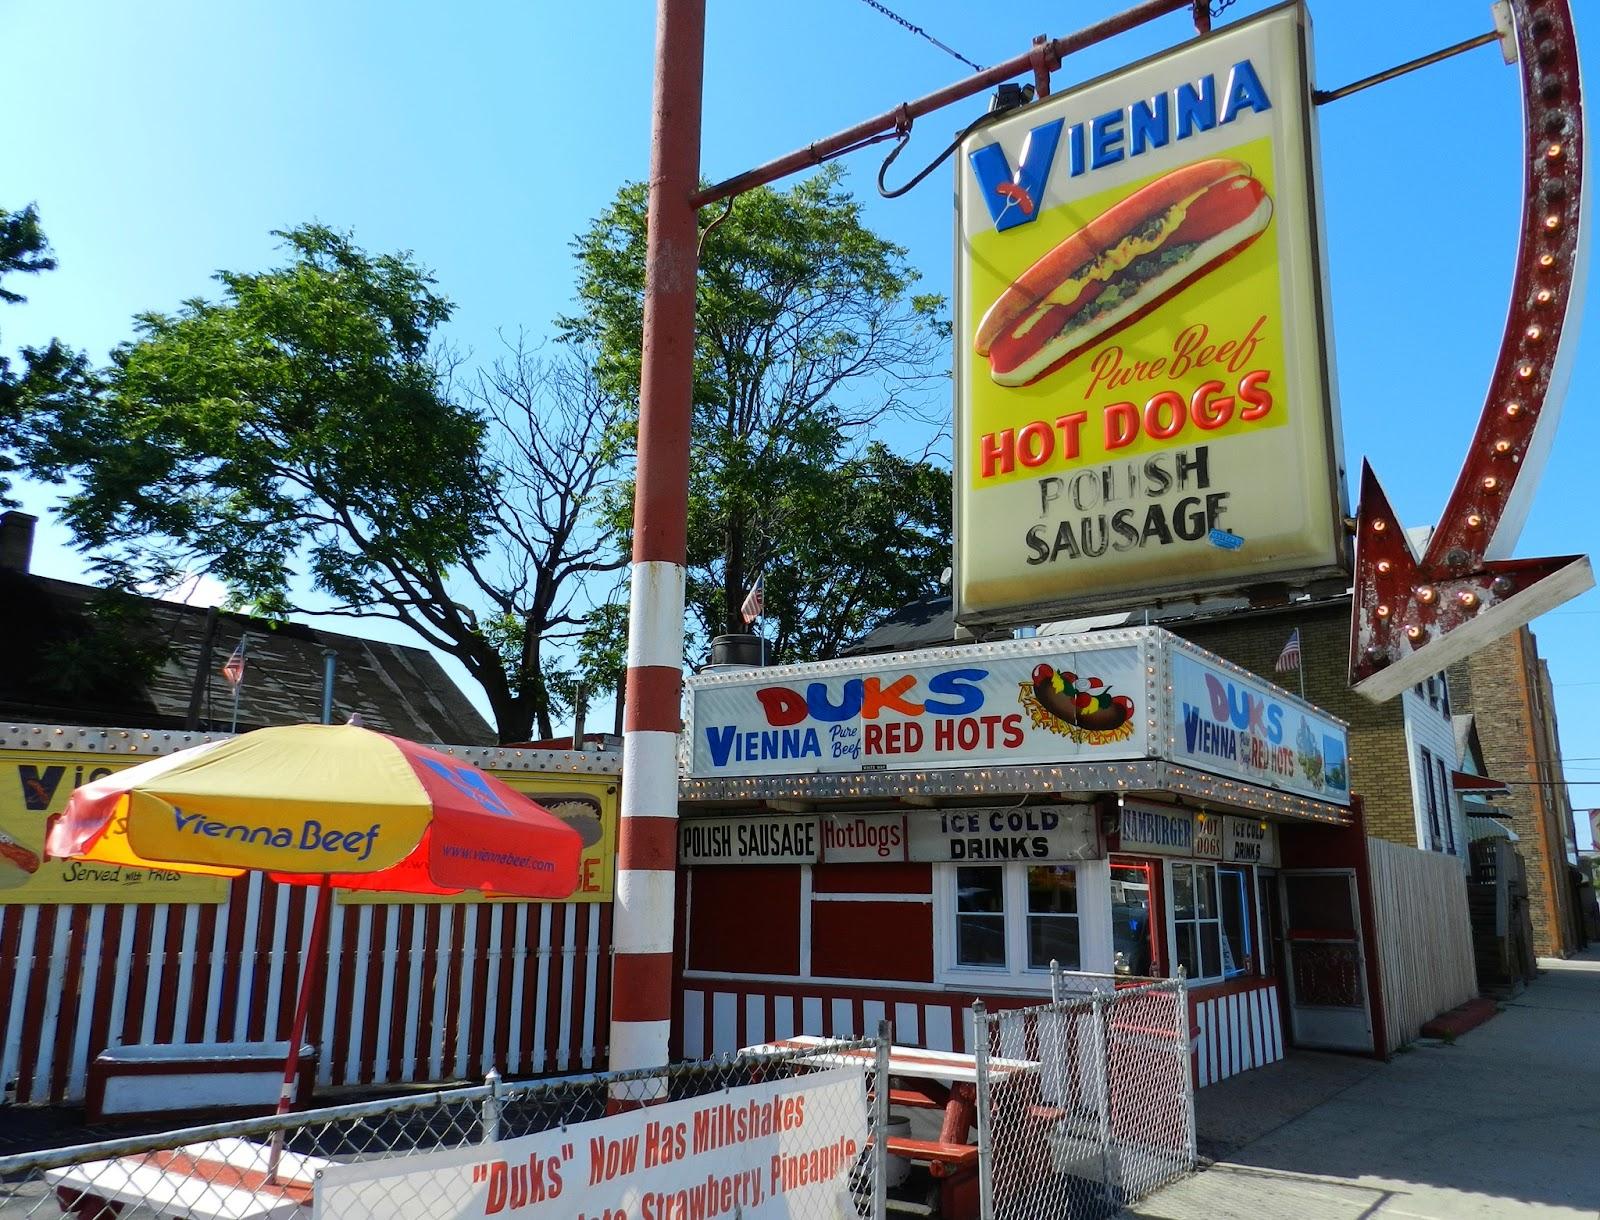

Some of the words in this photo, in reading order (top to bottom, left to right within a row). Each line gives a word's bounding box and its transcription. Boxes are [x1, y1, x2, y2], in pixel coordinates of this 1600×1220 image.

[968, 59, 1272, 232] VIENNA
[1084, 346, 1167, 399] Pure
[1168, 315, 1267, 379] Beef
[981, 411, 1088, 478] HOT
[1104, 370, 1273, 450] DOGS
[1038, 446, 1210, 519] POLISH
[1025, 491, 1232, 565] SAUSAGE
[756, 668, 989, 726] DUKS
[1204, 672, 1284, 745] DUKS
[706, 725, 821, 766] VIENNA
[829, 724, 858, 742] Pure
[831, 739, 861, 760] Beef
[864, 722, 923, 754] RED
[935, 714, 1025, 752] HOTS
[1183, 702, 1236, 761] VIENNA
[1251, 736, 1269, 770] RED
[1271, 745, 1295, 777] HOTS
[174, 806, 293, 848] Vienna
[298, 820, 381, 861] Beef
[683, 824, 731, 857] POLISH
[738, 822, 815, 856] SAUSAGE
[824, 819, 900, 857] HotDogs
[940, 811, 980, 833] ICE
[989, 809, 1059, 831] COLD
[1122, 809, 1192, 848] HAMBURGER
[1233, 821, 1245, 838] ICE
[442, 844, 555, 873] www.viennabeef.com
[950, 837, 1049, 859] DRINKS
[1197, 837, 1220, 856] DOGS
[1235, 841, 1261, 859] DRINKS
[63, 861, 122, 882] Served
[473, 1144, 574, 1215] "Duks"
[589, 1134, 639, 1186] Now
[644, 1120, 687, 1168] Has
[693, 1094, 805, 1155] Milkshakes
